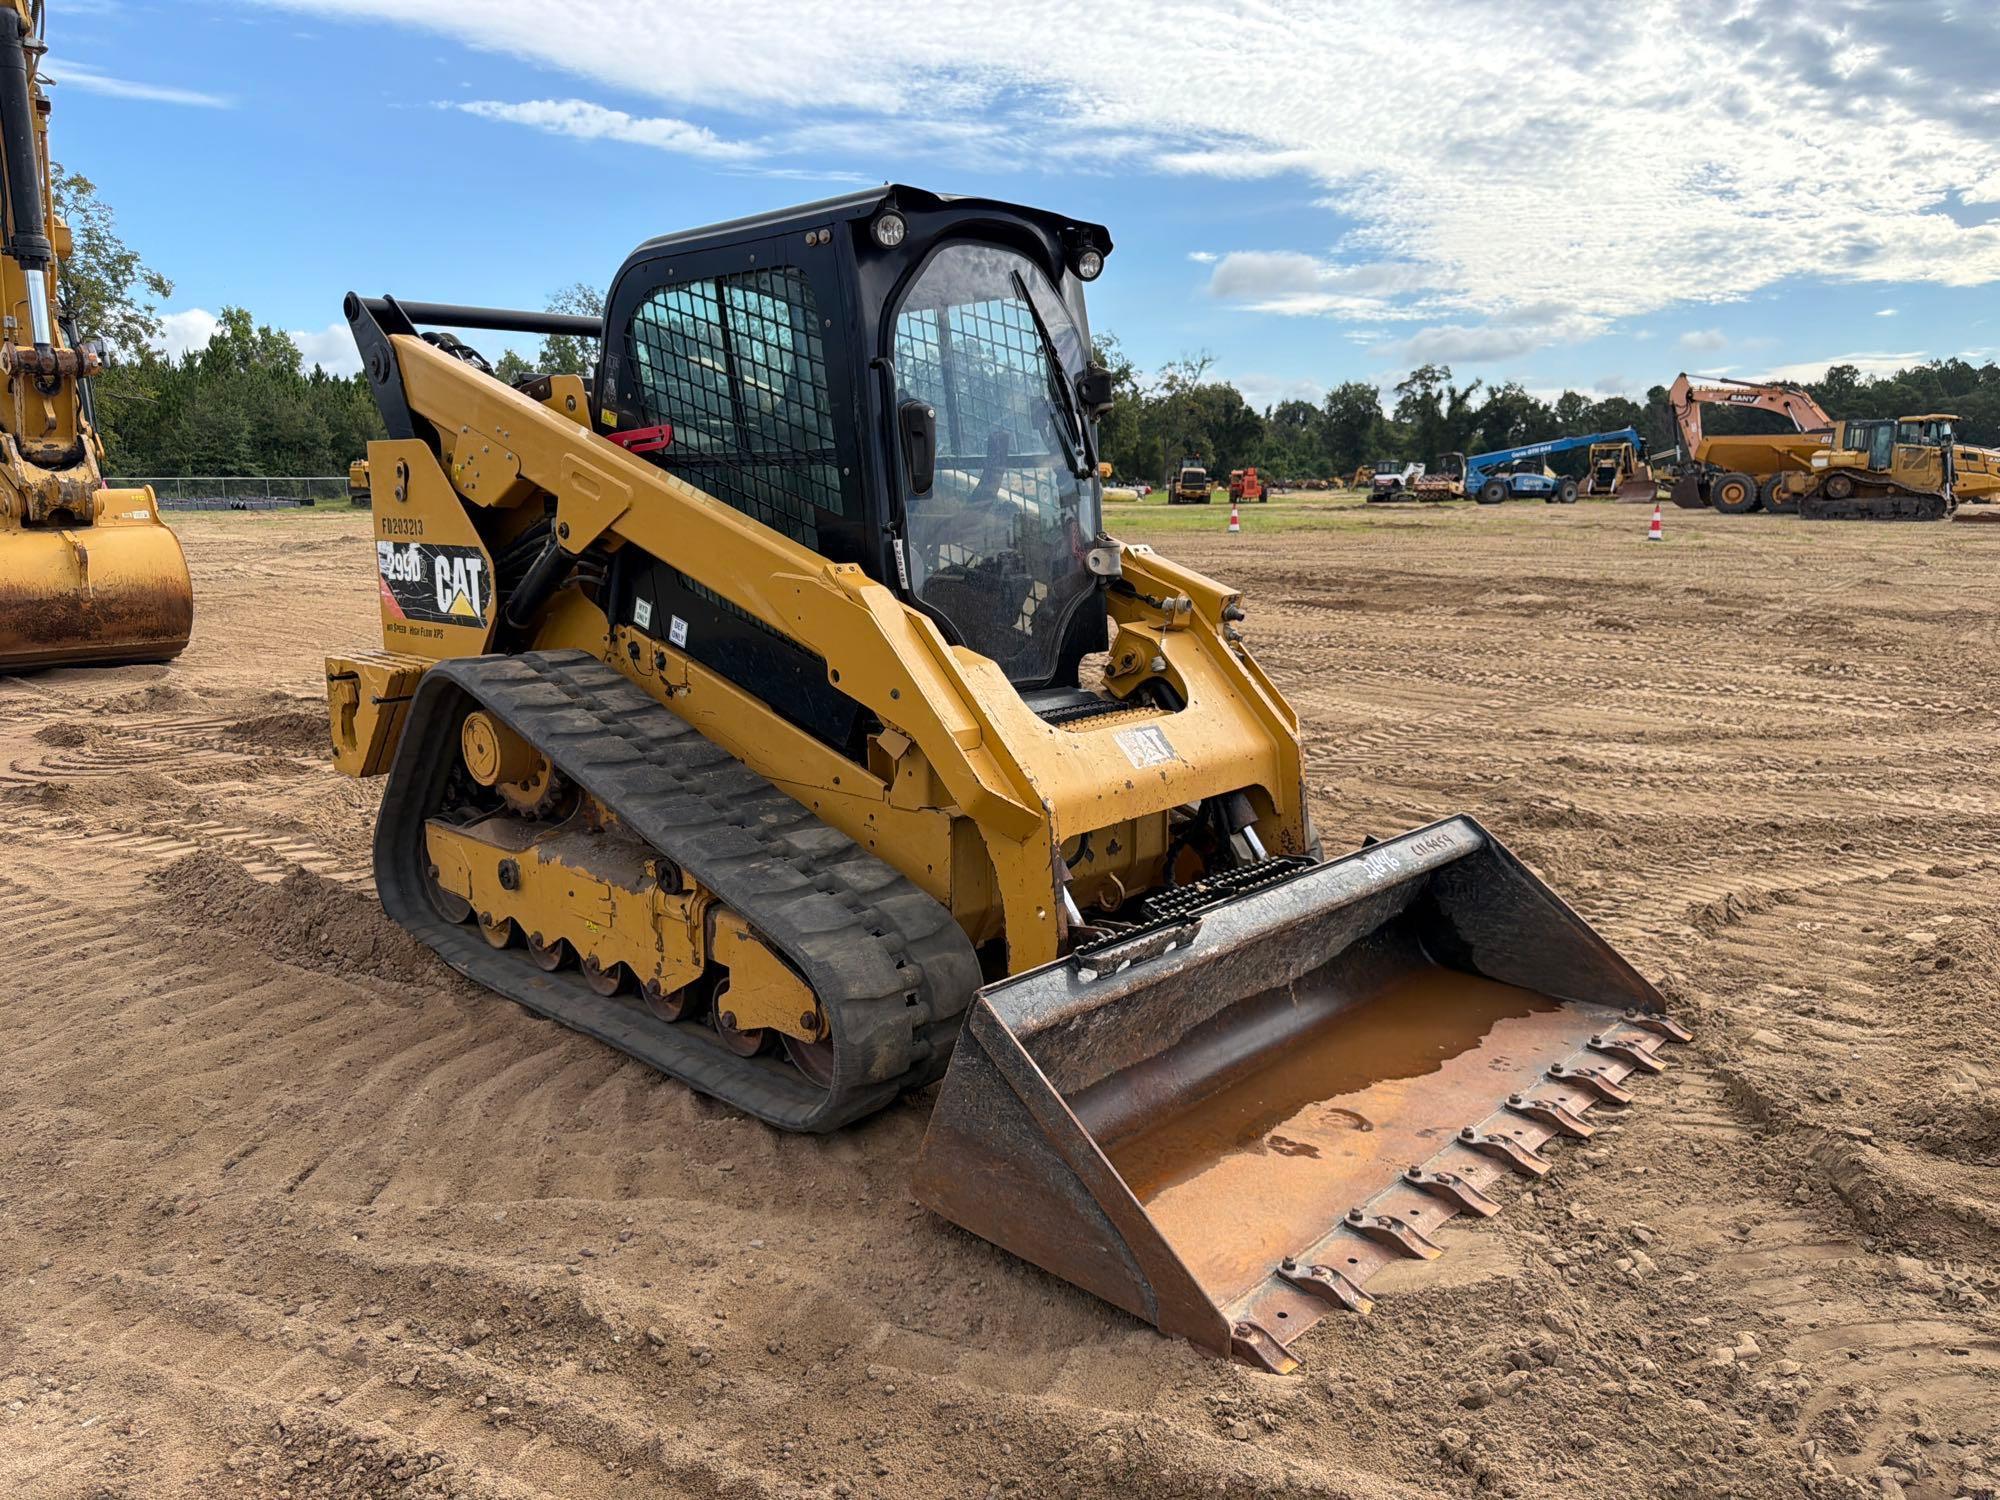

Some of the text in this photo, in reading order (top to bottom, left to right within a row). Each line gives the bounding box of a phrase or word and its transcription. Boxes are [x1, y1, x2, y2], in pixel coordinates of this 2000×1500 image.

[1731, 394, 1755, 402] SANY
[382, 517, 424, 535] FD203213
[434, 555, 482, 618] CAT
[674, 620, 685, 631] DEF
[671, 629, 685, 643] ONLY
